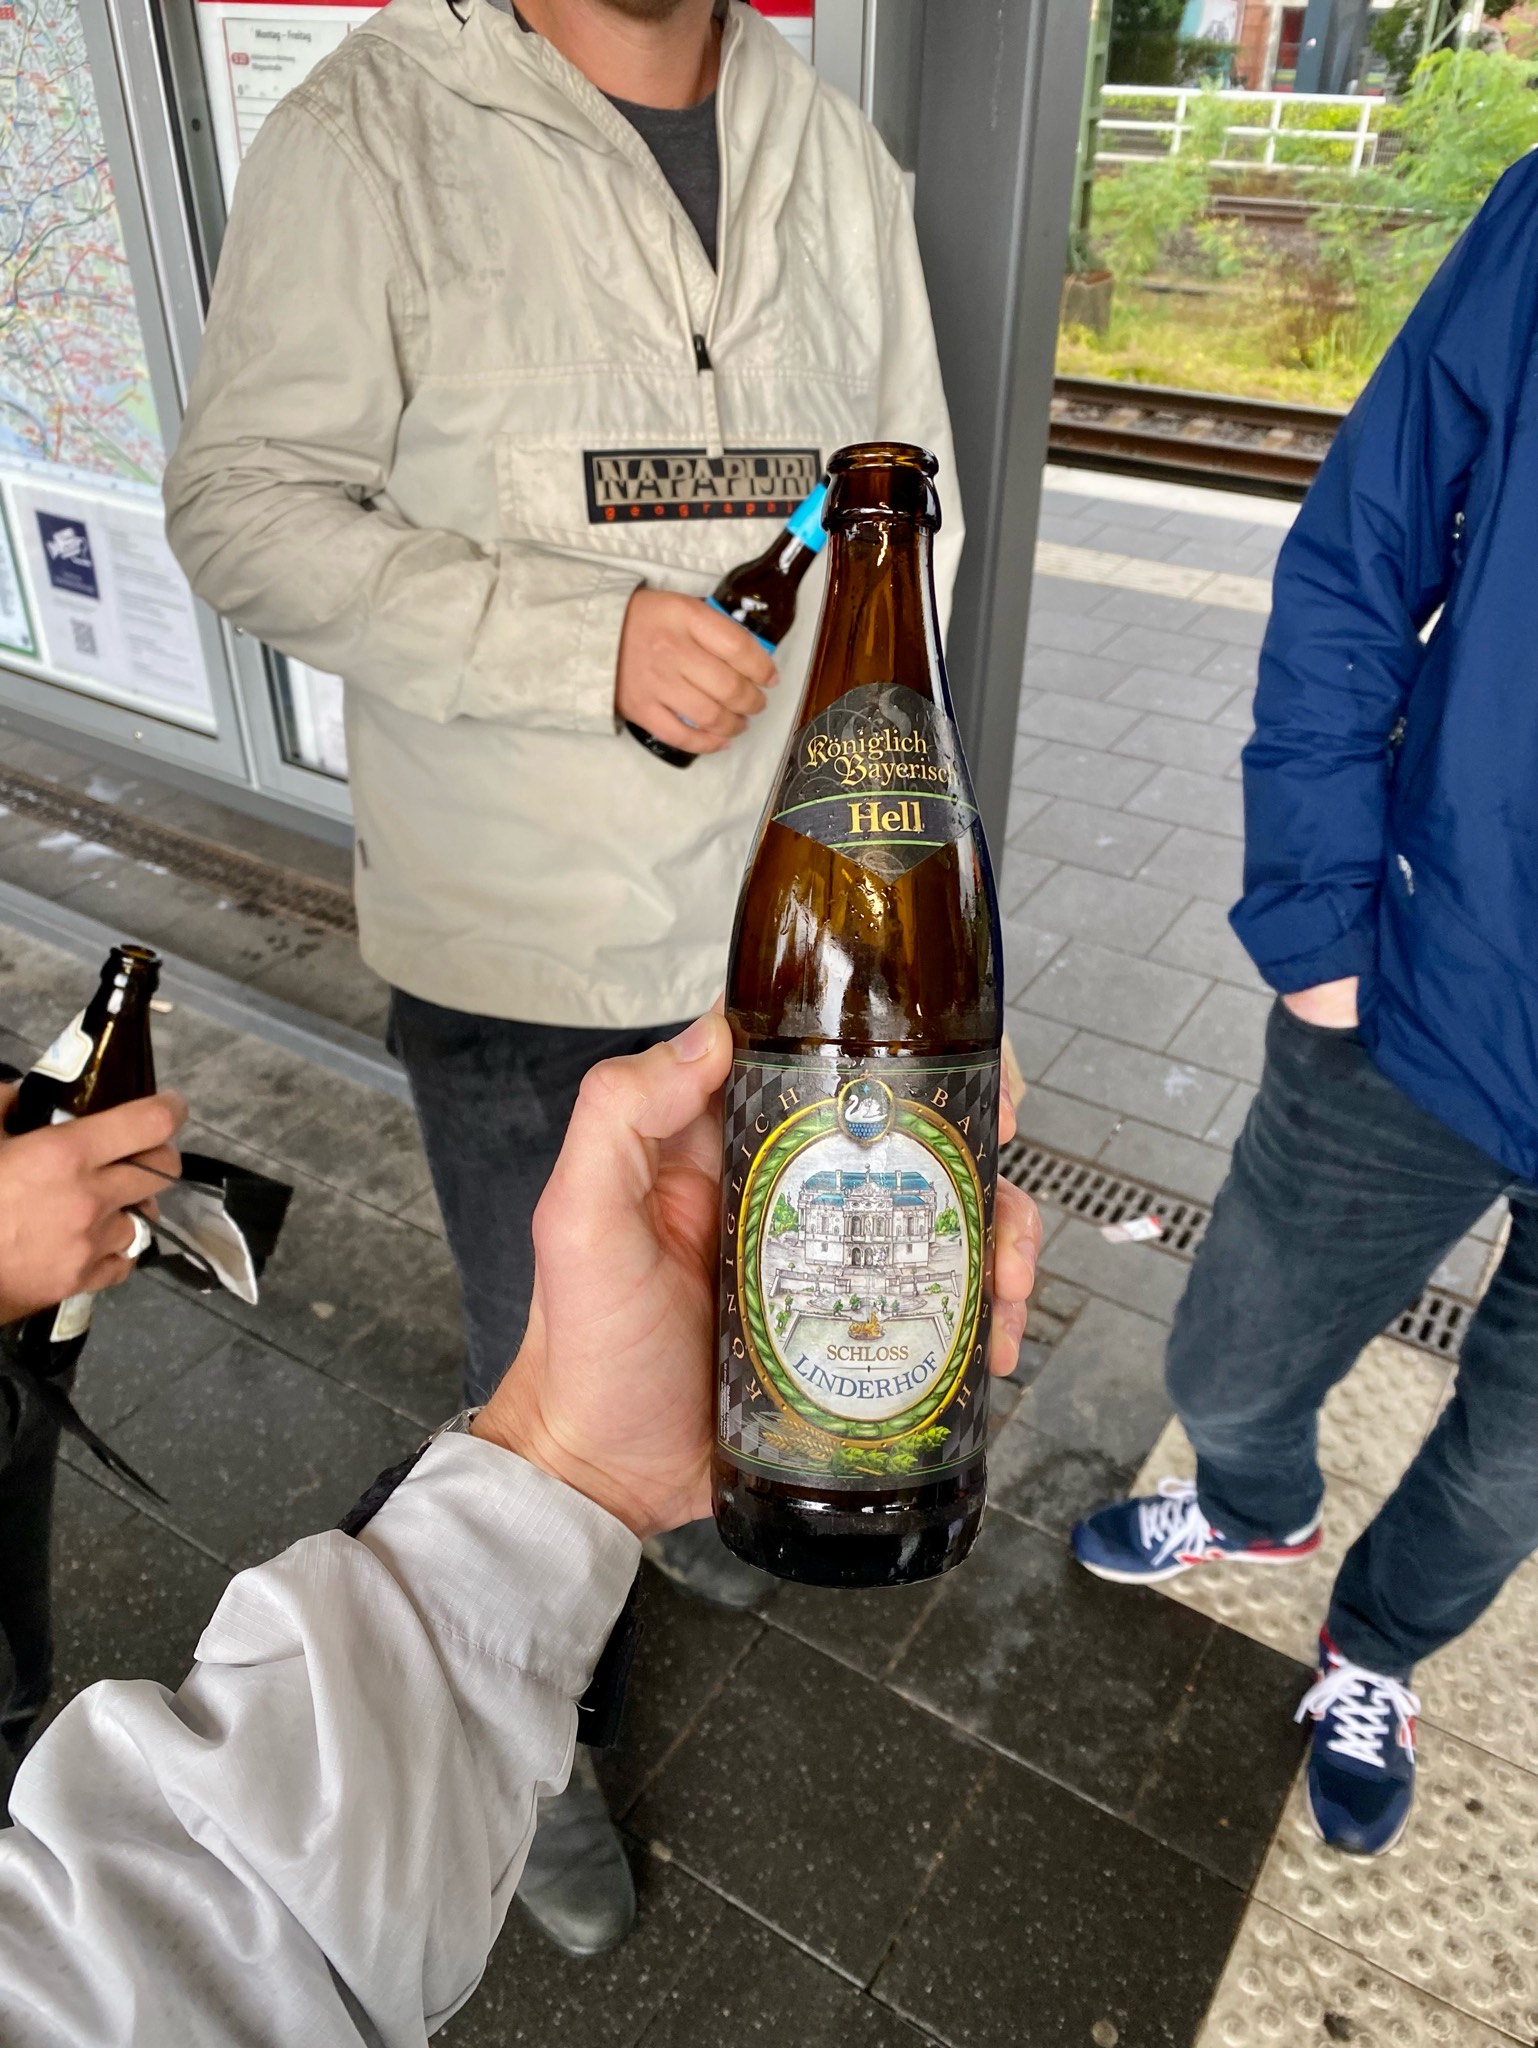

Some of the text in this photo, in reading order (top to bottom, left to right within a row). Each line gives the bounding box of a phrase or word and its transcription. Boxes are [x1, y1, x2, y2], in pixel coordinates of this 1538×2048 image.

[597, 456, 813, 500] NAPAPIJRI
[605, 502, 794, 521] geographi
[806, 728, 928, 768] Königlich
[833, 753, 959, 787] Bayerisch
[847, 801, 925, 834] Hell
[726, 1087, 800, 1403] KÖNIGLICH
[826, 1344, 909, 1362] SCHLOSS
[792, 1351, 938, 1400] LINDERHOF
